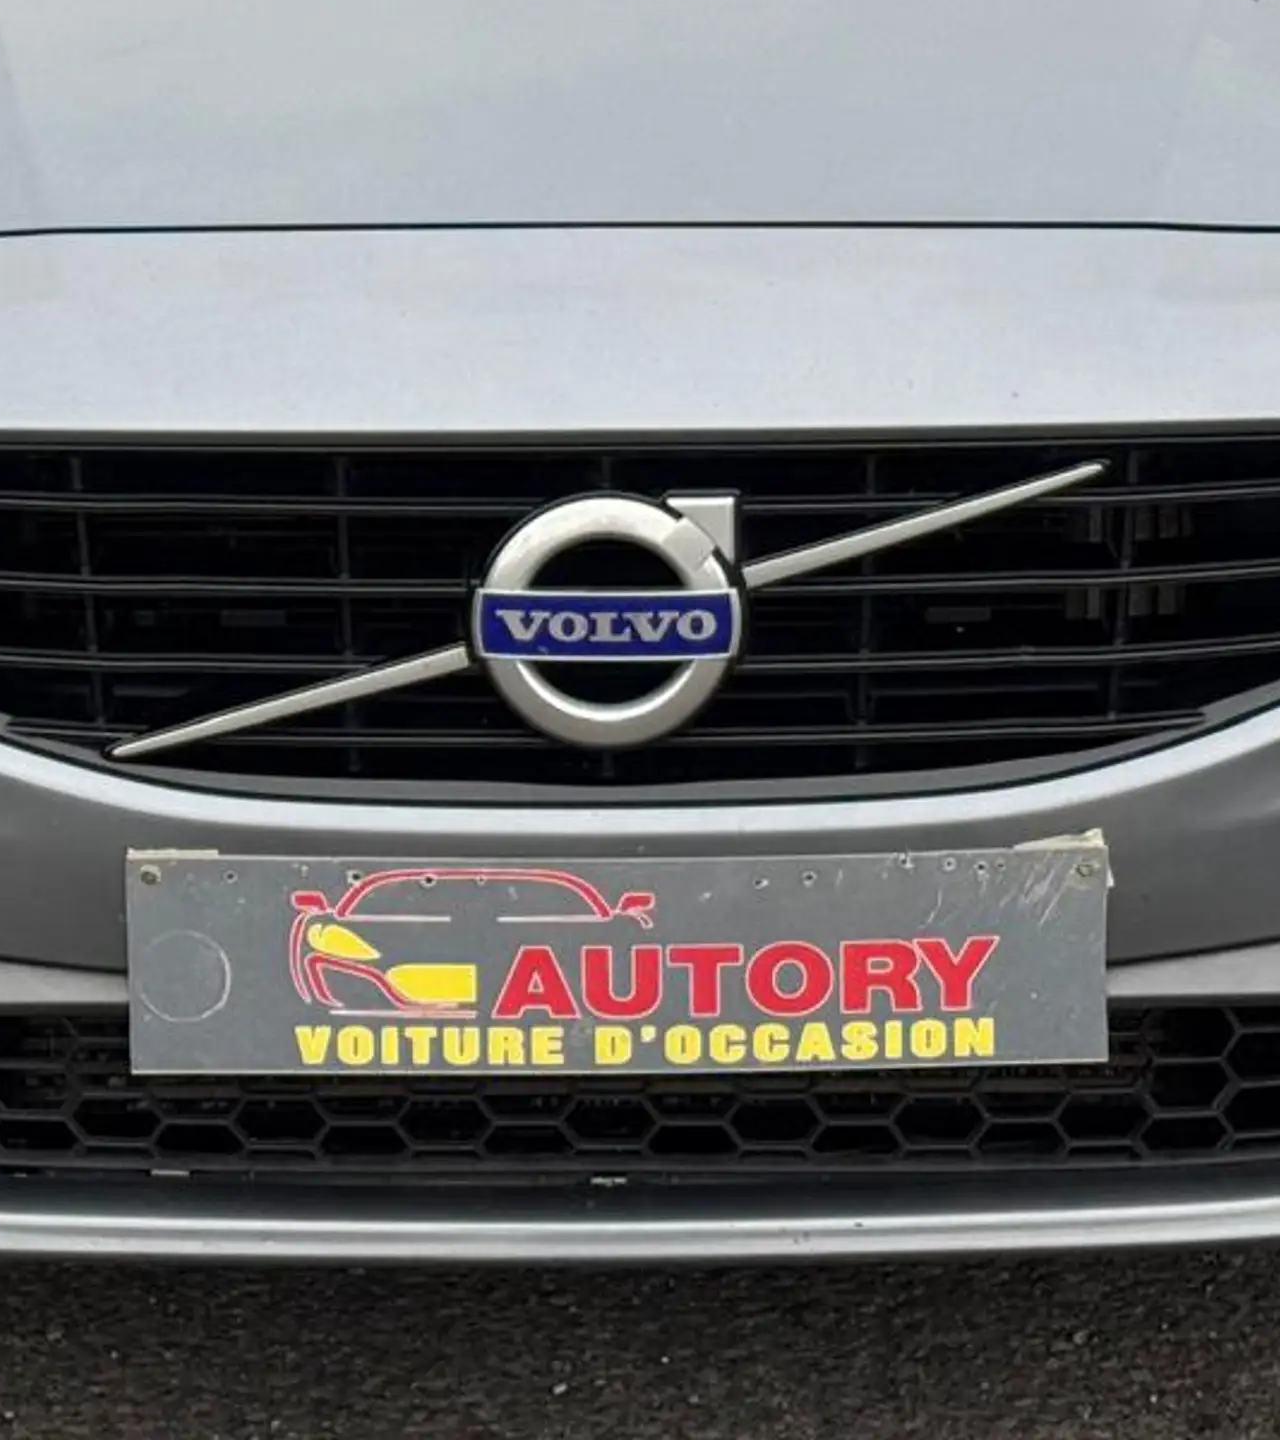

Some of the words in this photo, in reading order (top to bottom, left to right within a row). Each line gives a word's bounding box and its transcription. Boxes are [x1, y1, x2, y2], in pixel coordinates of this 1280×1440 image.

[495, 609, 718, 642] VOLVO
[491, 935, 1000, 1020] AUTORY
[294, 1024, 565, 1066] VOITURE
[594, 1017, 995, 1066] D'OCCASION
